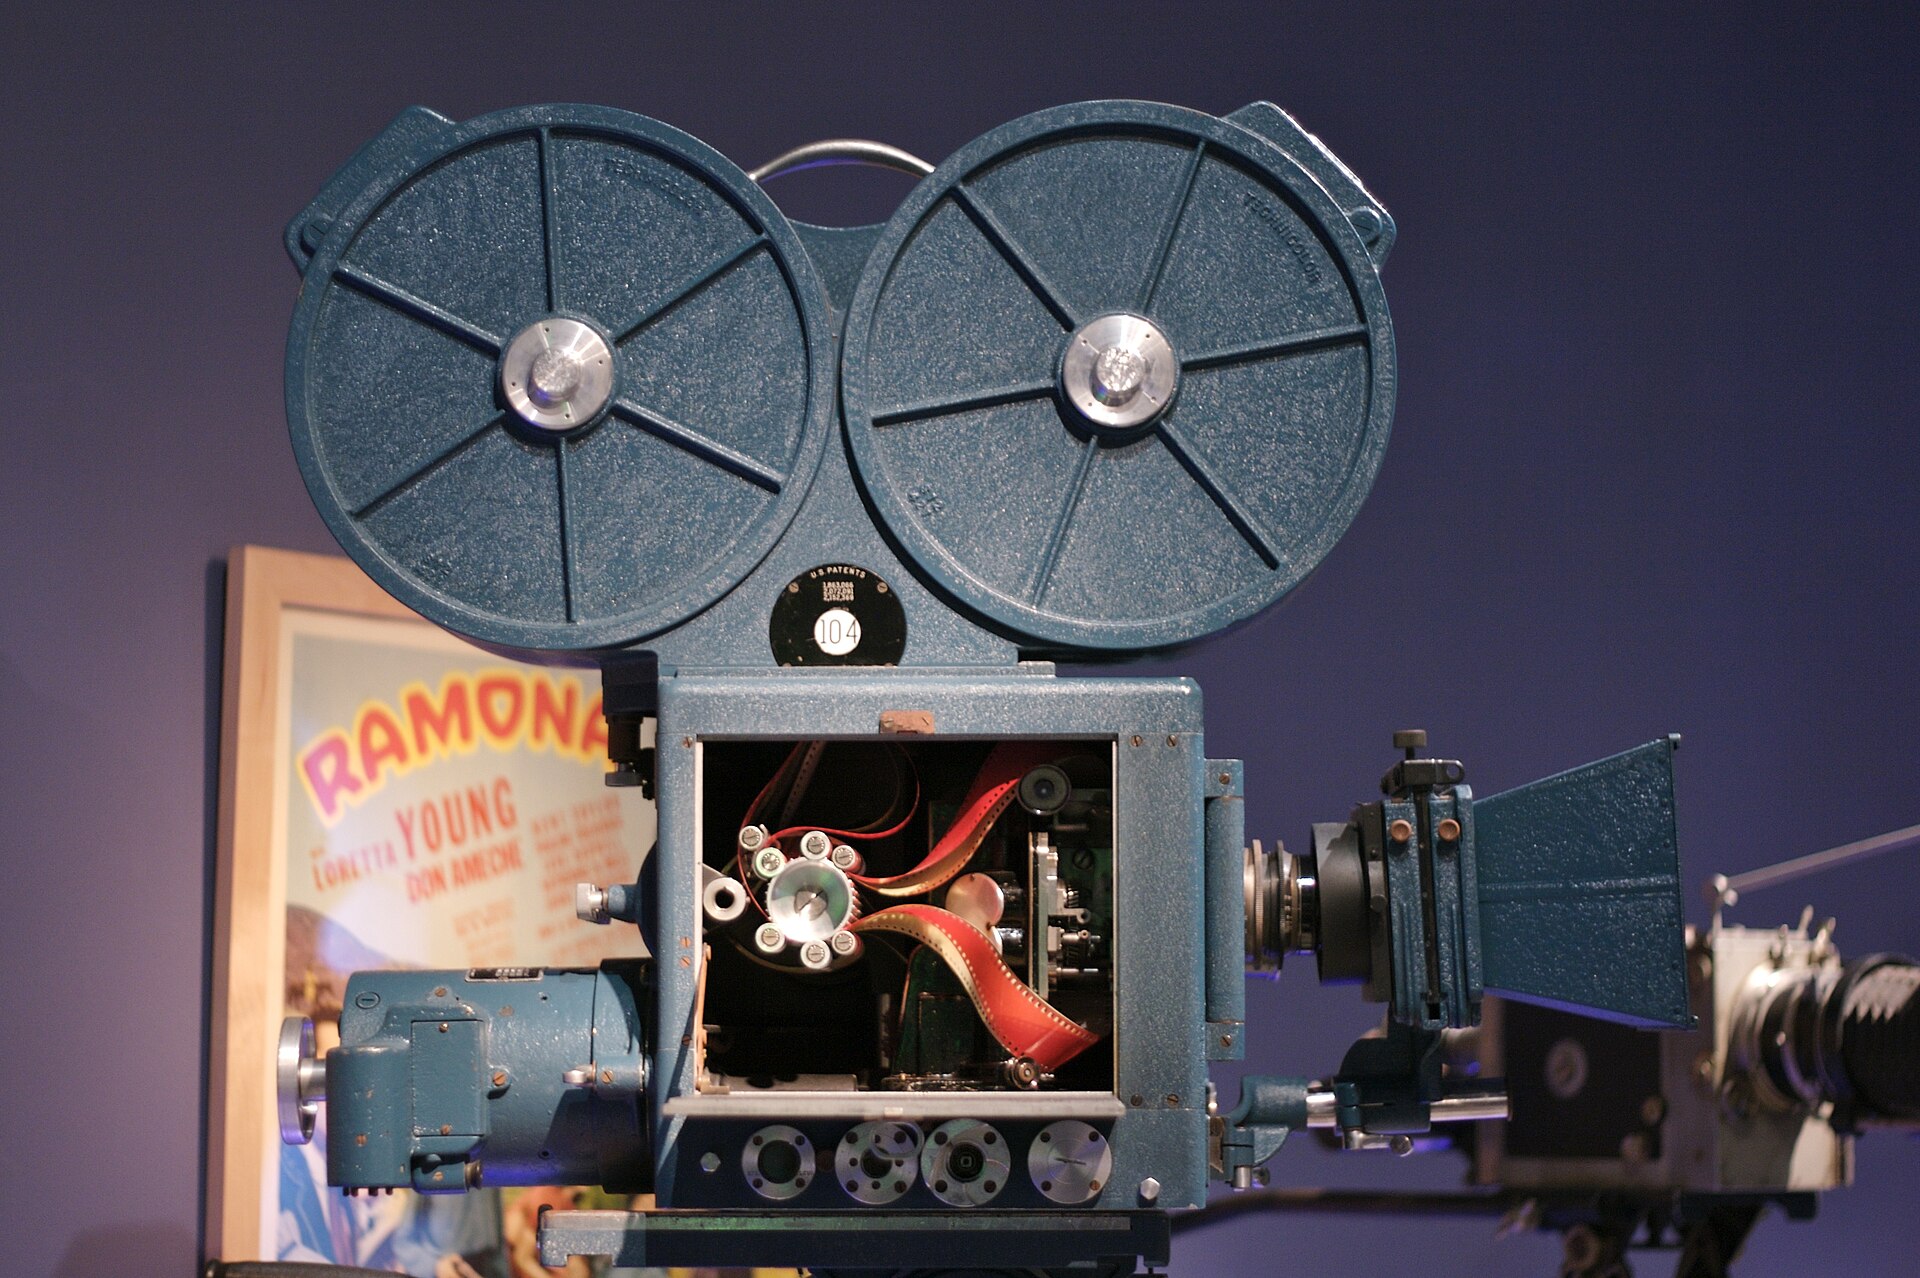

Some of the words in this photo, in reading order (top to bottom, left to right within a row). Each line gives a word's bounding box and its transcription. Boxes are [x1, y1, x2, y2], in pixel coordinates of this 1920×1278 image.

[827, 566, 866, 578] PATENTS
[820, 619, 858, 644] 104
[309, 840, 397, 893] LORETTA
[394, 775, 518, 861] YOUNG
[404, 865, 448, 905] DON
